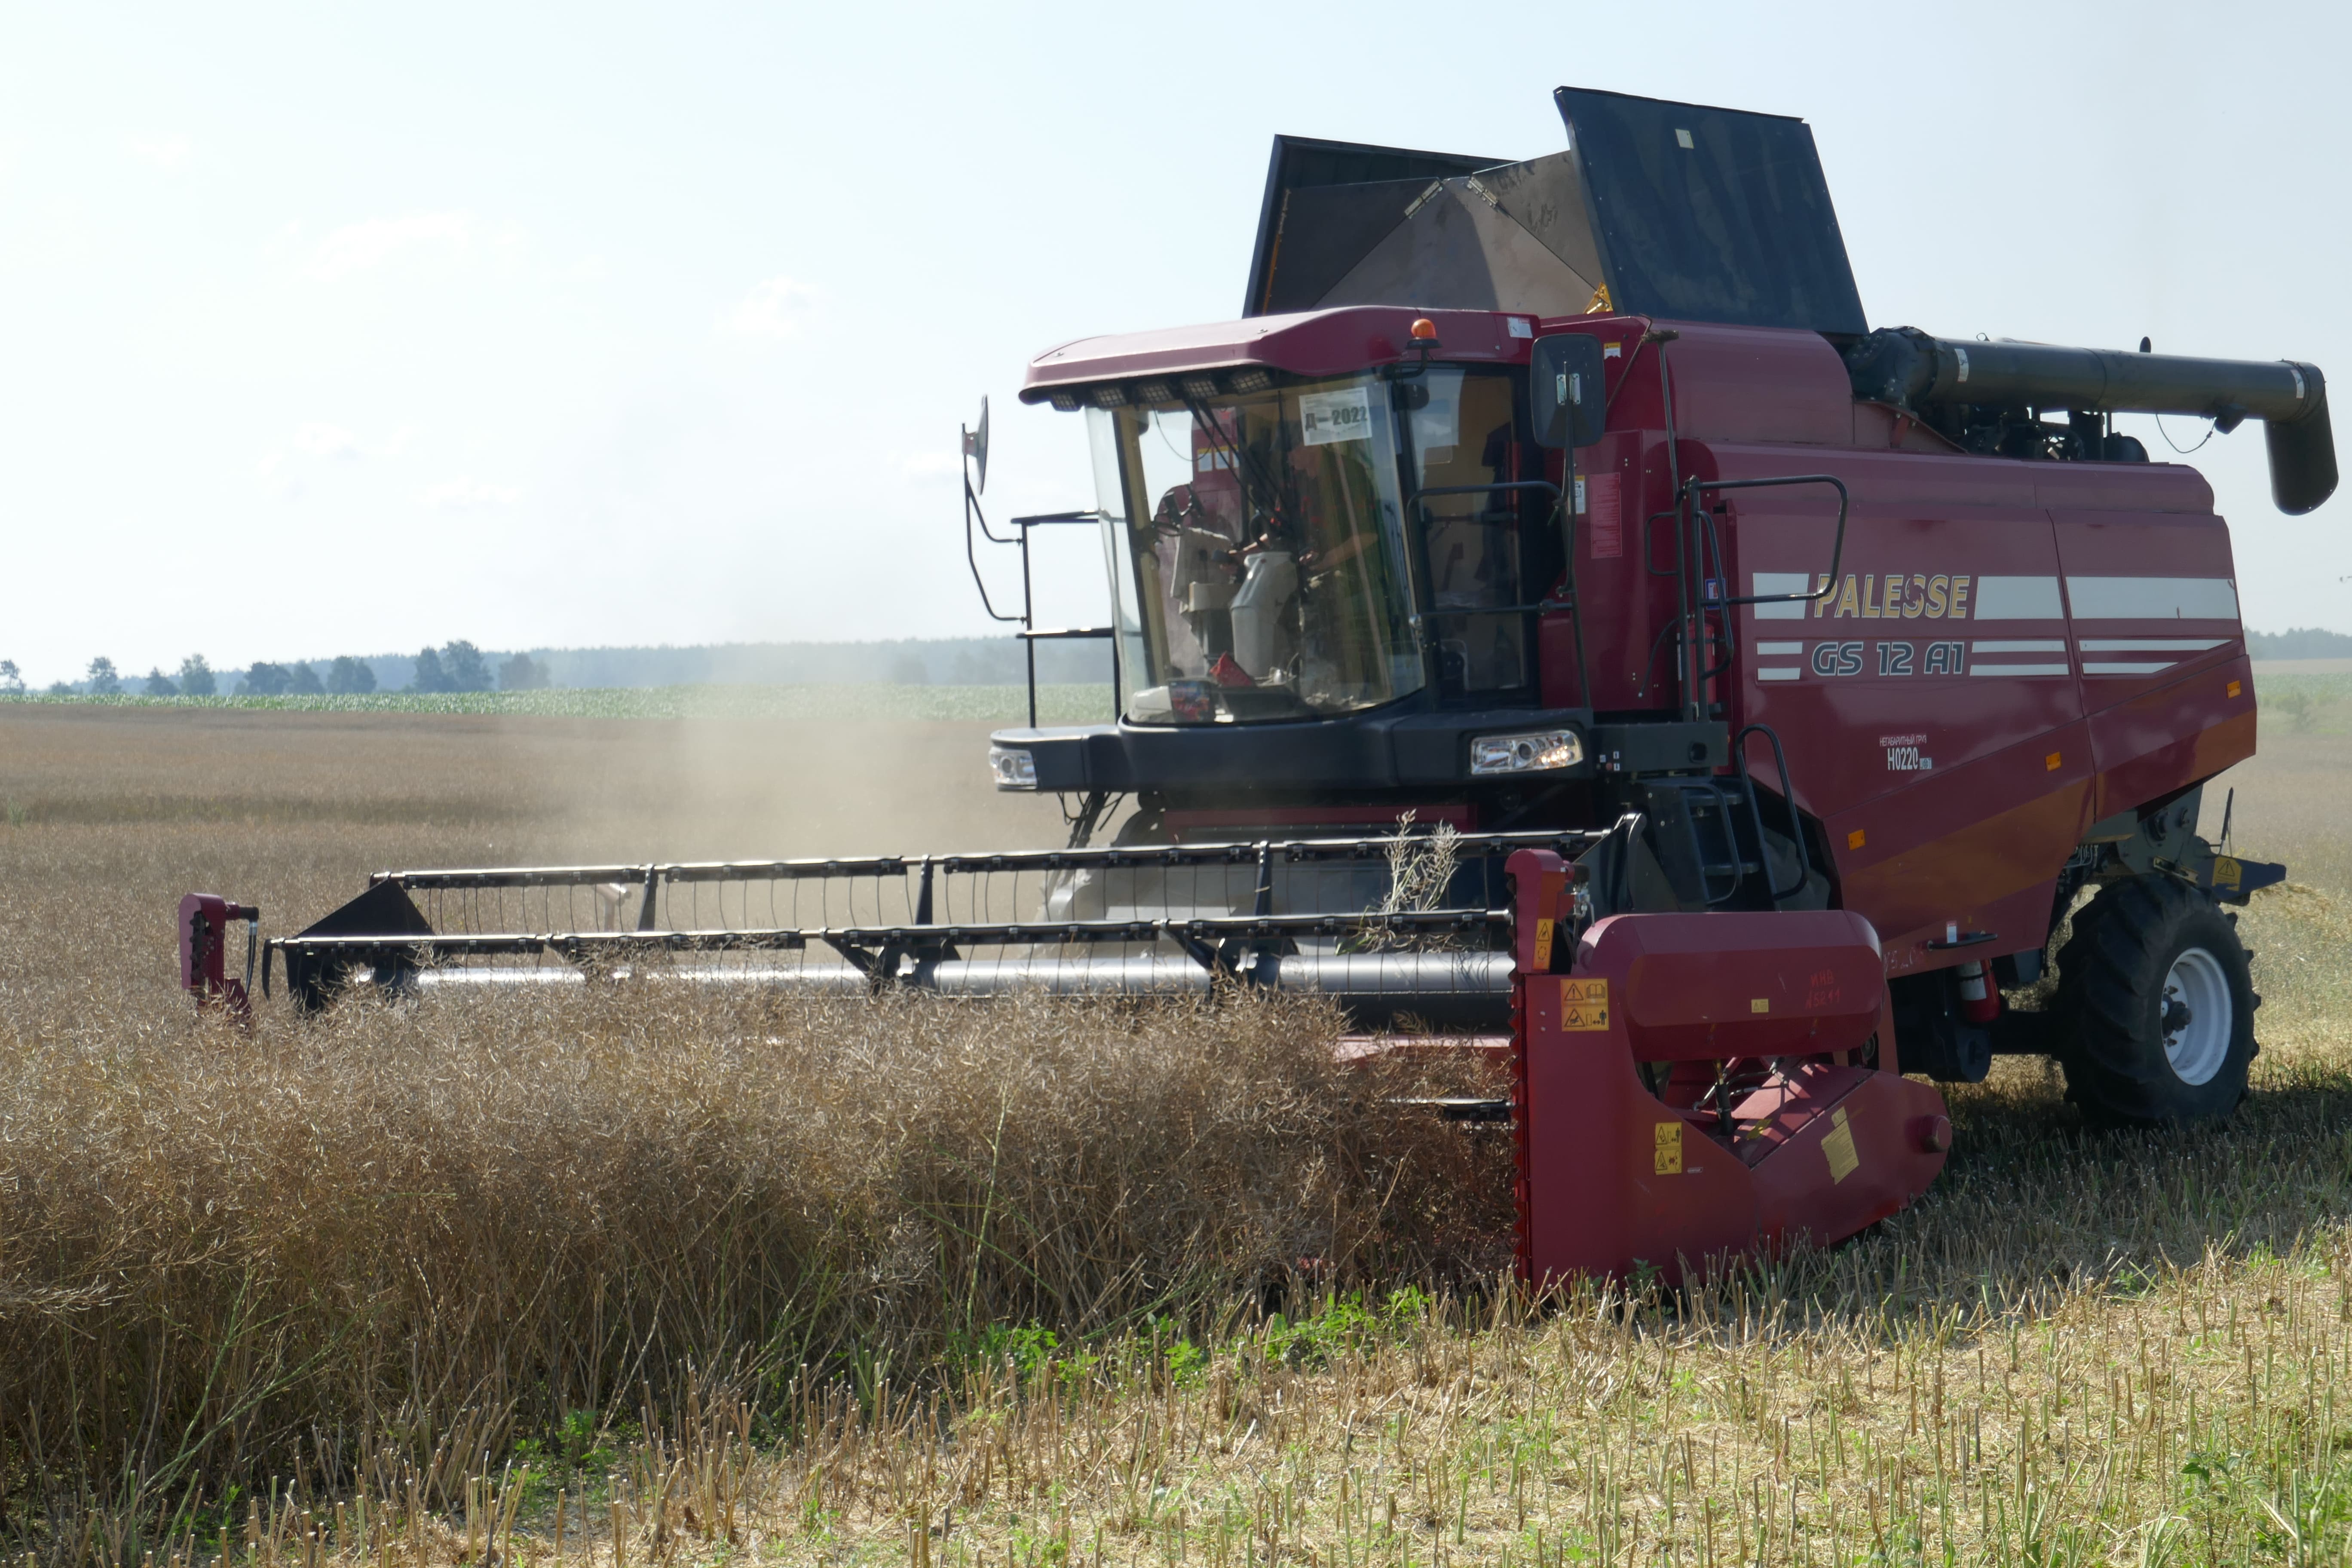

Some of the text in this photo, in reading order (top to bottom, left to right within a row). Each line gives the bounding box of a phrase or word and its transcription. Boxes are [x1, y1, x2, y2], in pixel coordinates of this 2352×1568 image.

[1814, 574, 1970, 619] PALESSE
[1812, 641, 1965, 676] GS 12 A1
